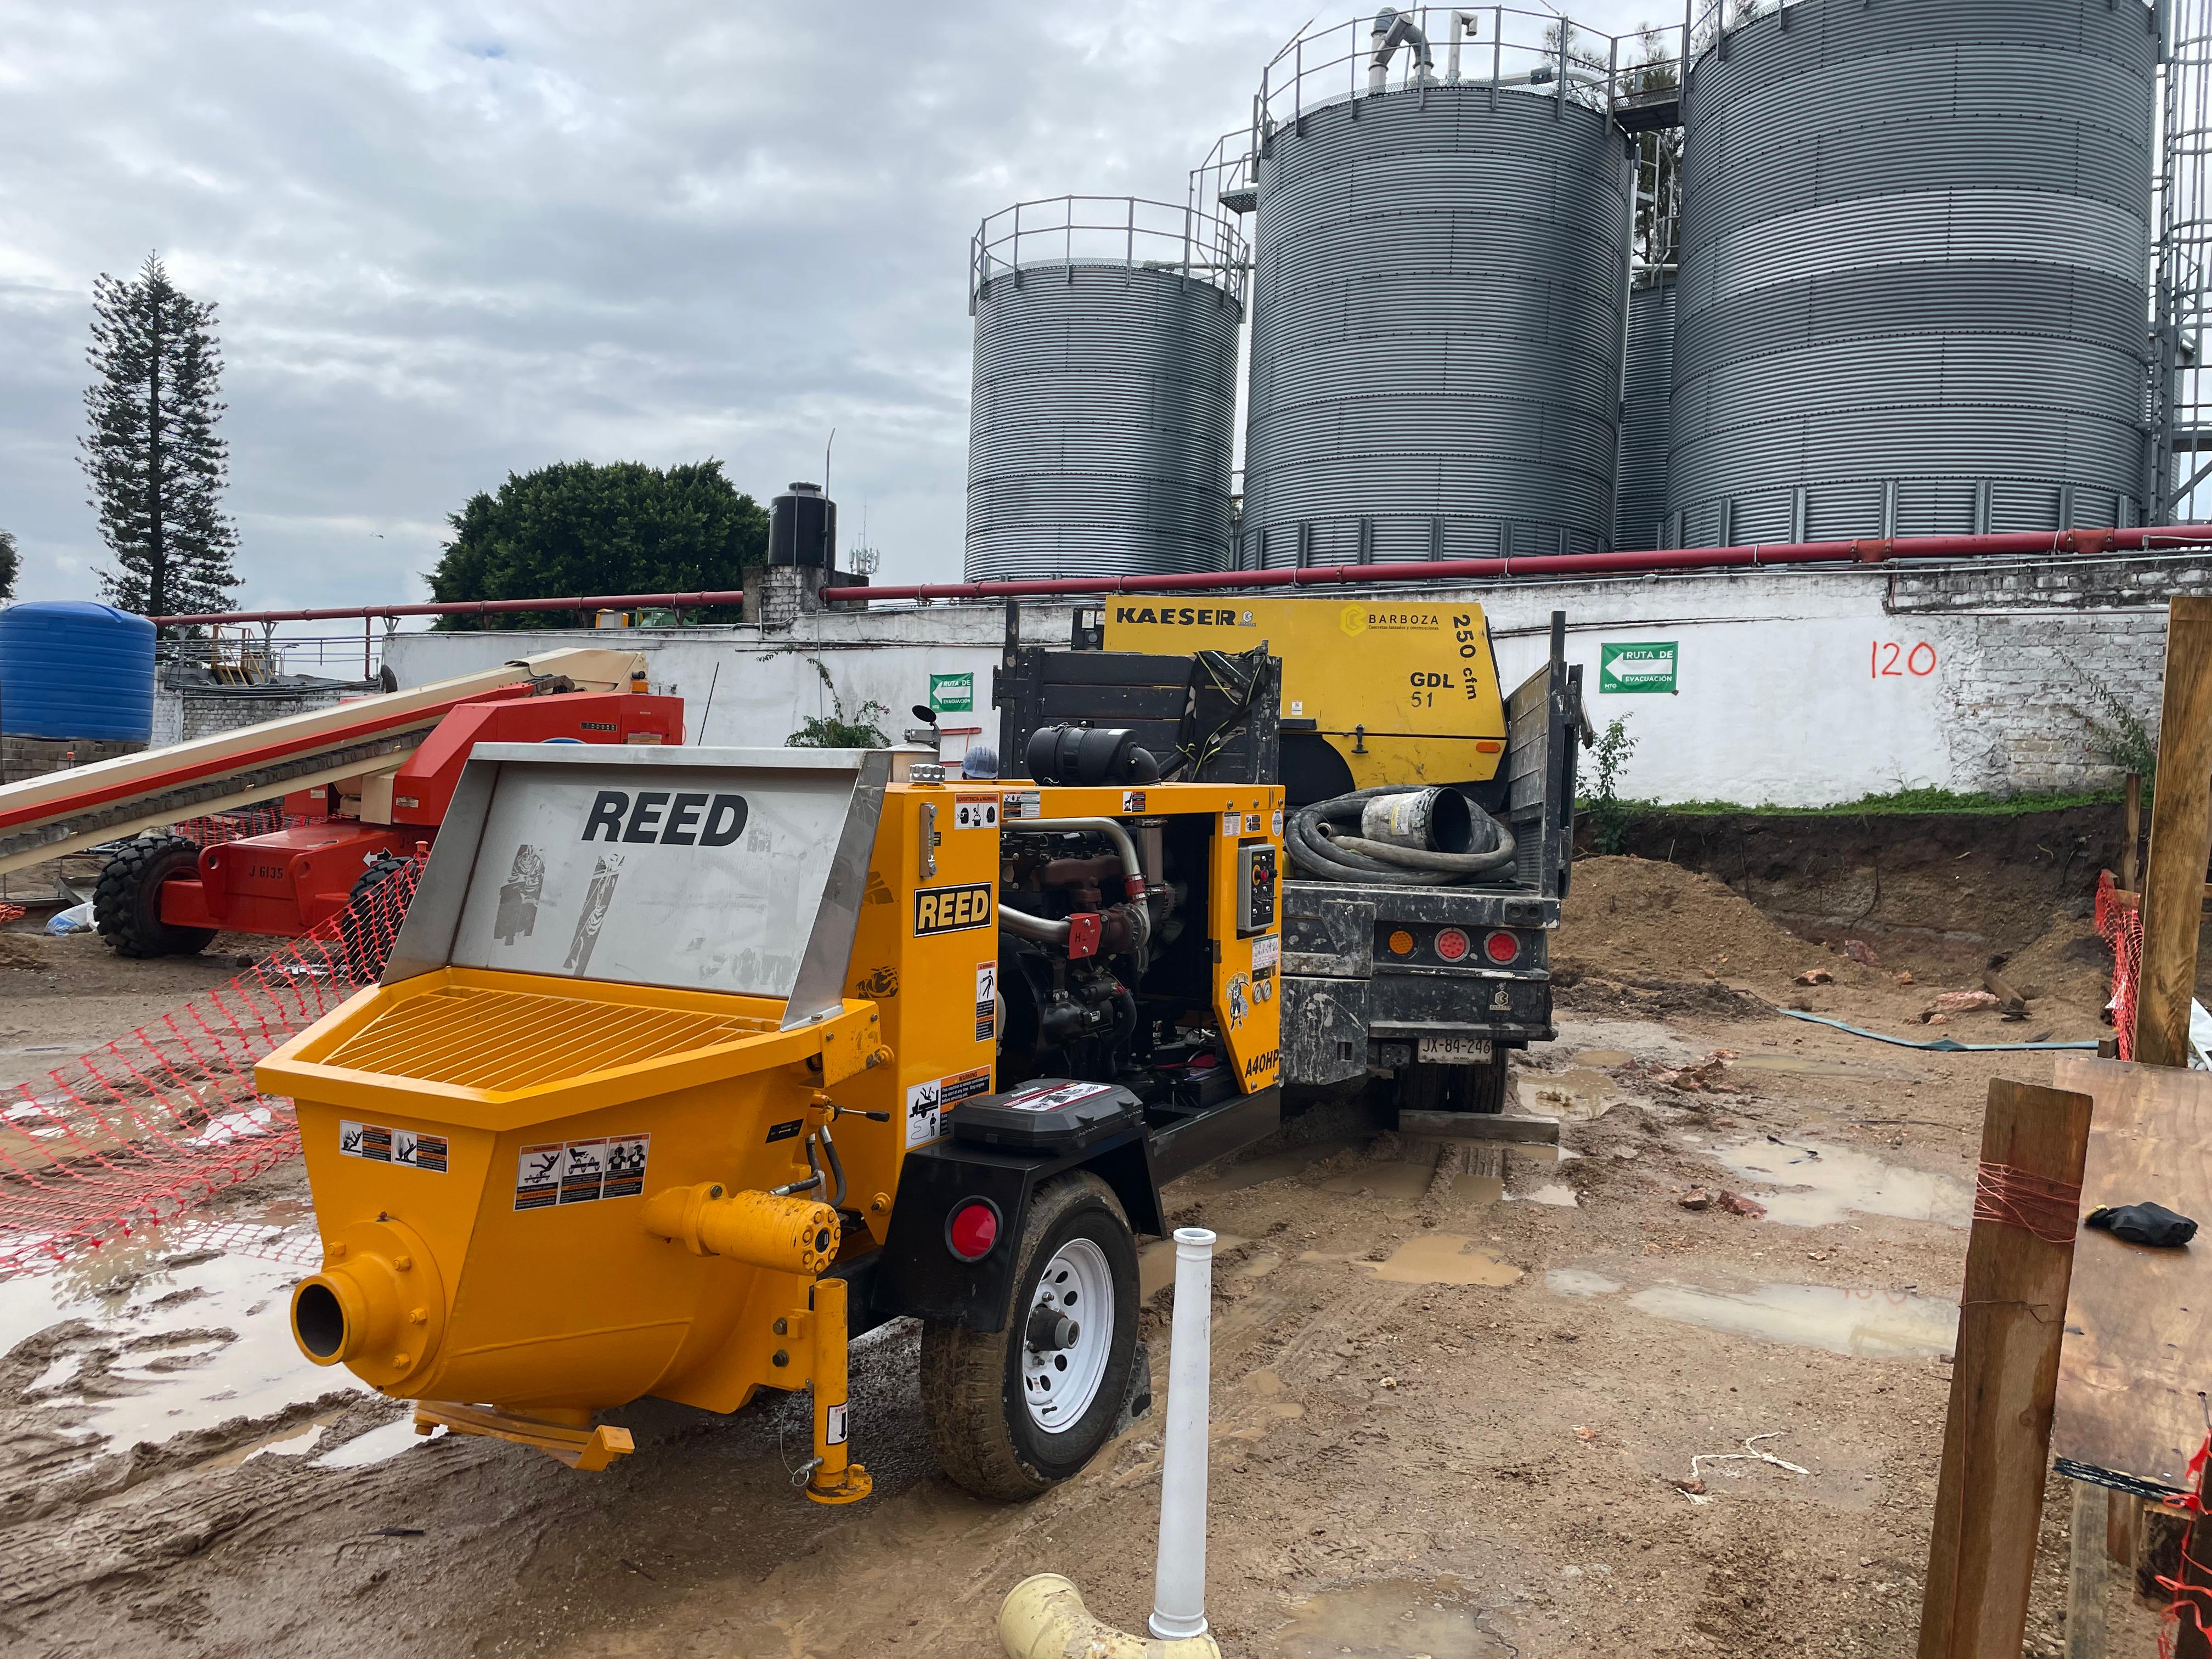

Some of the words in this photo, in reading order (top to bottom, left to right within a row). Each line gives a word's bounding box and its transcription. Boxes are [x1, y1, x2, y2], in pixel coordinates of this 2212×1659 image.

[1116, 608, 1236, 625] KAESER
[1369, 614, 1438, 624] BARBOZA
[1453, 614, 1477, 658] 250
[1871, 641, 1937, 679] 120
[1410, 672, 1454, 688] GDL
[1463, 667, 1478, 700] cfm
[1411, 691, 1433, 708] 51
[581, 791, 748, 847] REED
[249, 865, 255, 877] J
[918, 890, 989, 929] REED
[1423, 1038, 1491, 1053] JX-84-246
[1244, 1049, 1279, 1078] A40HP
[958, 1071, 978, 1081] WARNING
